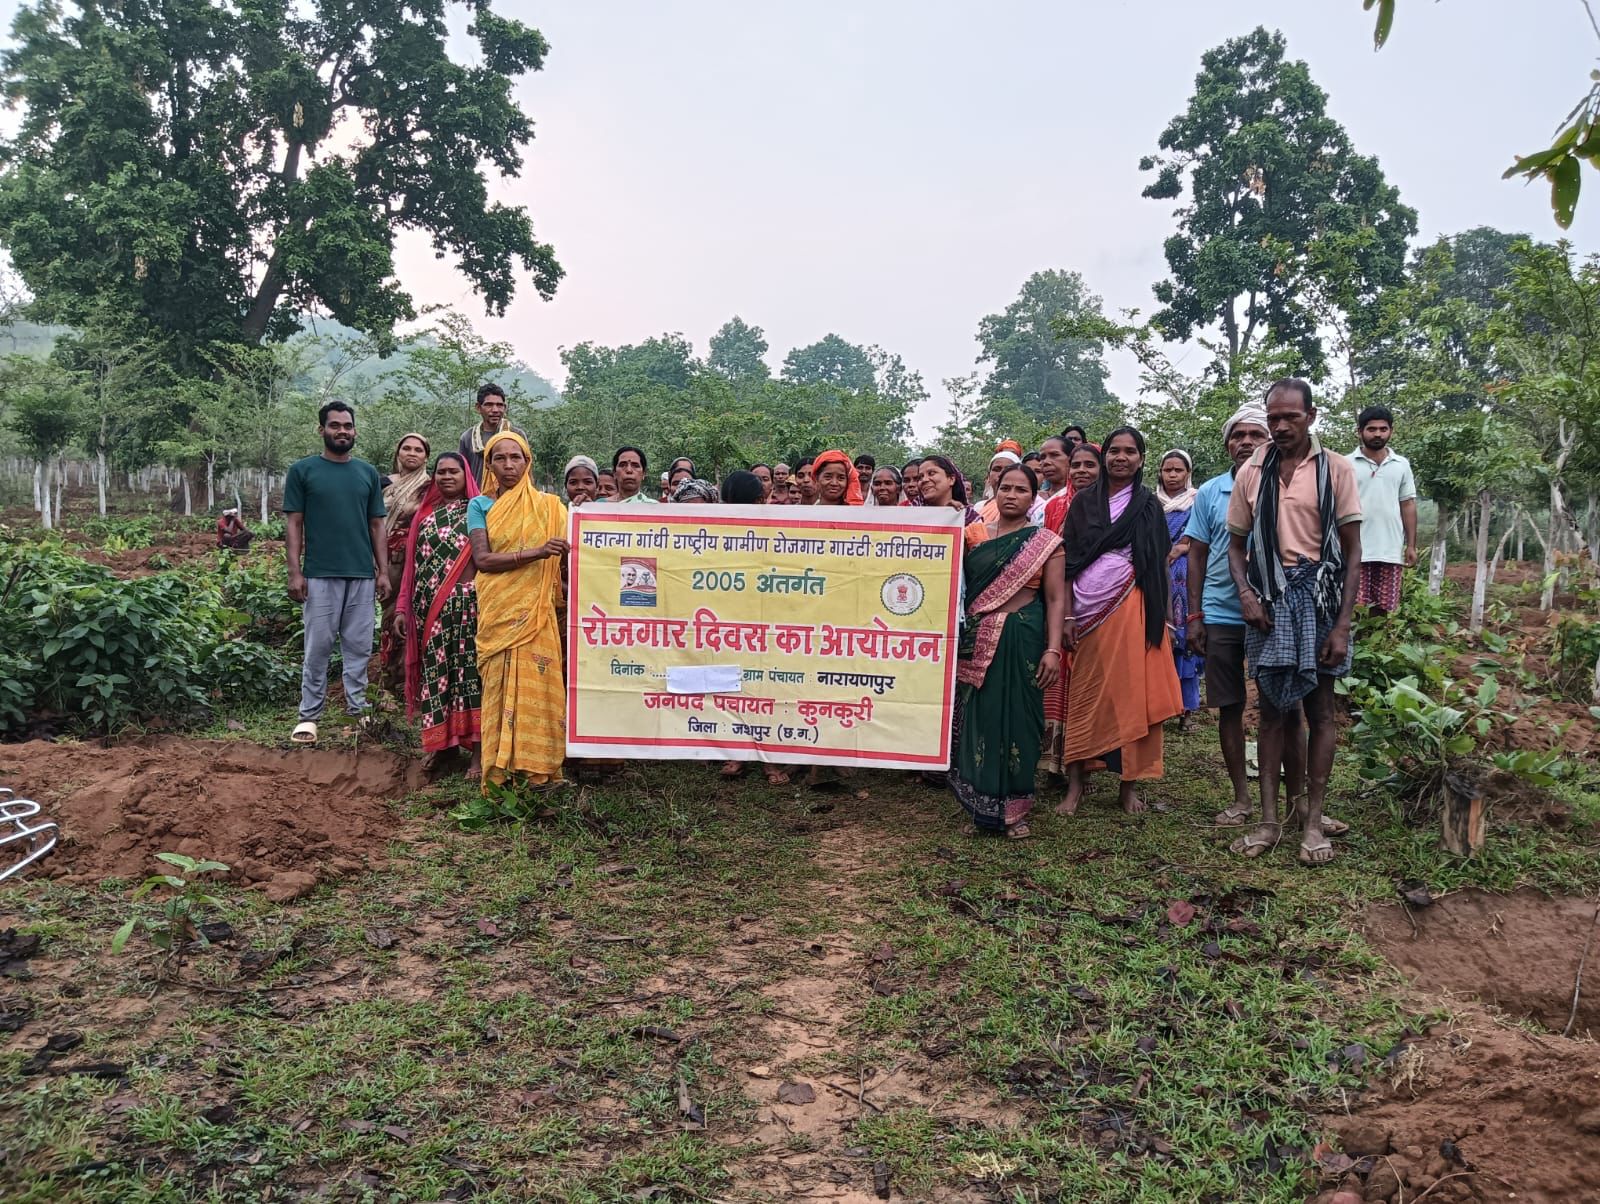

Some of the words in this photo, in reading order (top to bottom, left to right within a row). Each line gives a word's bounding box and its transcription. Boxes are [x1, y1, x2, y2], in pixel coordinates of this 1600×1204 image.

[583, 531, 632, 548] महात्मा
[637, 527, 669, 550] गांधी
[673, 528, 720, 554] राष्ट्रीय
[723, 530, 769, 552] ग्रामीण
[773, 532, 825, 555] रोजगार
[829, 534, 871, 557] गारंटी
[875, 536, 947, 561] अधिनियम
[692, 570, 746, 592] 2005
[756, 567, 826, 596] अंतर्गत
[582, 604, 688, 649] रोजगार
[692, 607, 769, 653] दिवस
[775, 624, 814, 655] का
[819, 616, 943, 663] आयोजन
[610, 658, 645, 676] दिनांक
[743, 668, 764, 682] ग्राम
[768, 667, 805, 684] पंचायत
[817, 671, 896, 695] नारायणपुर
[643, 692, 705, 712] जनपद
[797, 696, 874, 728] कुनकुरी
[688, 716, 717, 734] जिला
[732, 722, 771, 742] जशपुर
